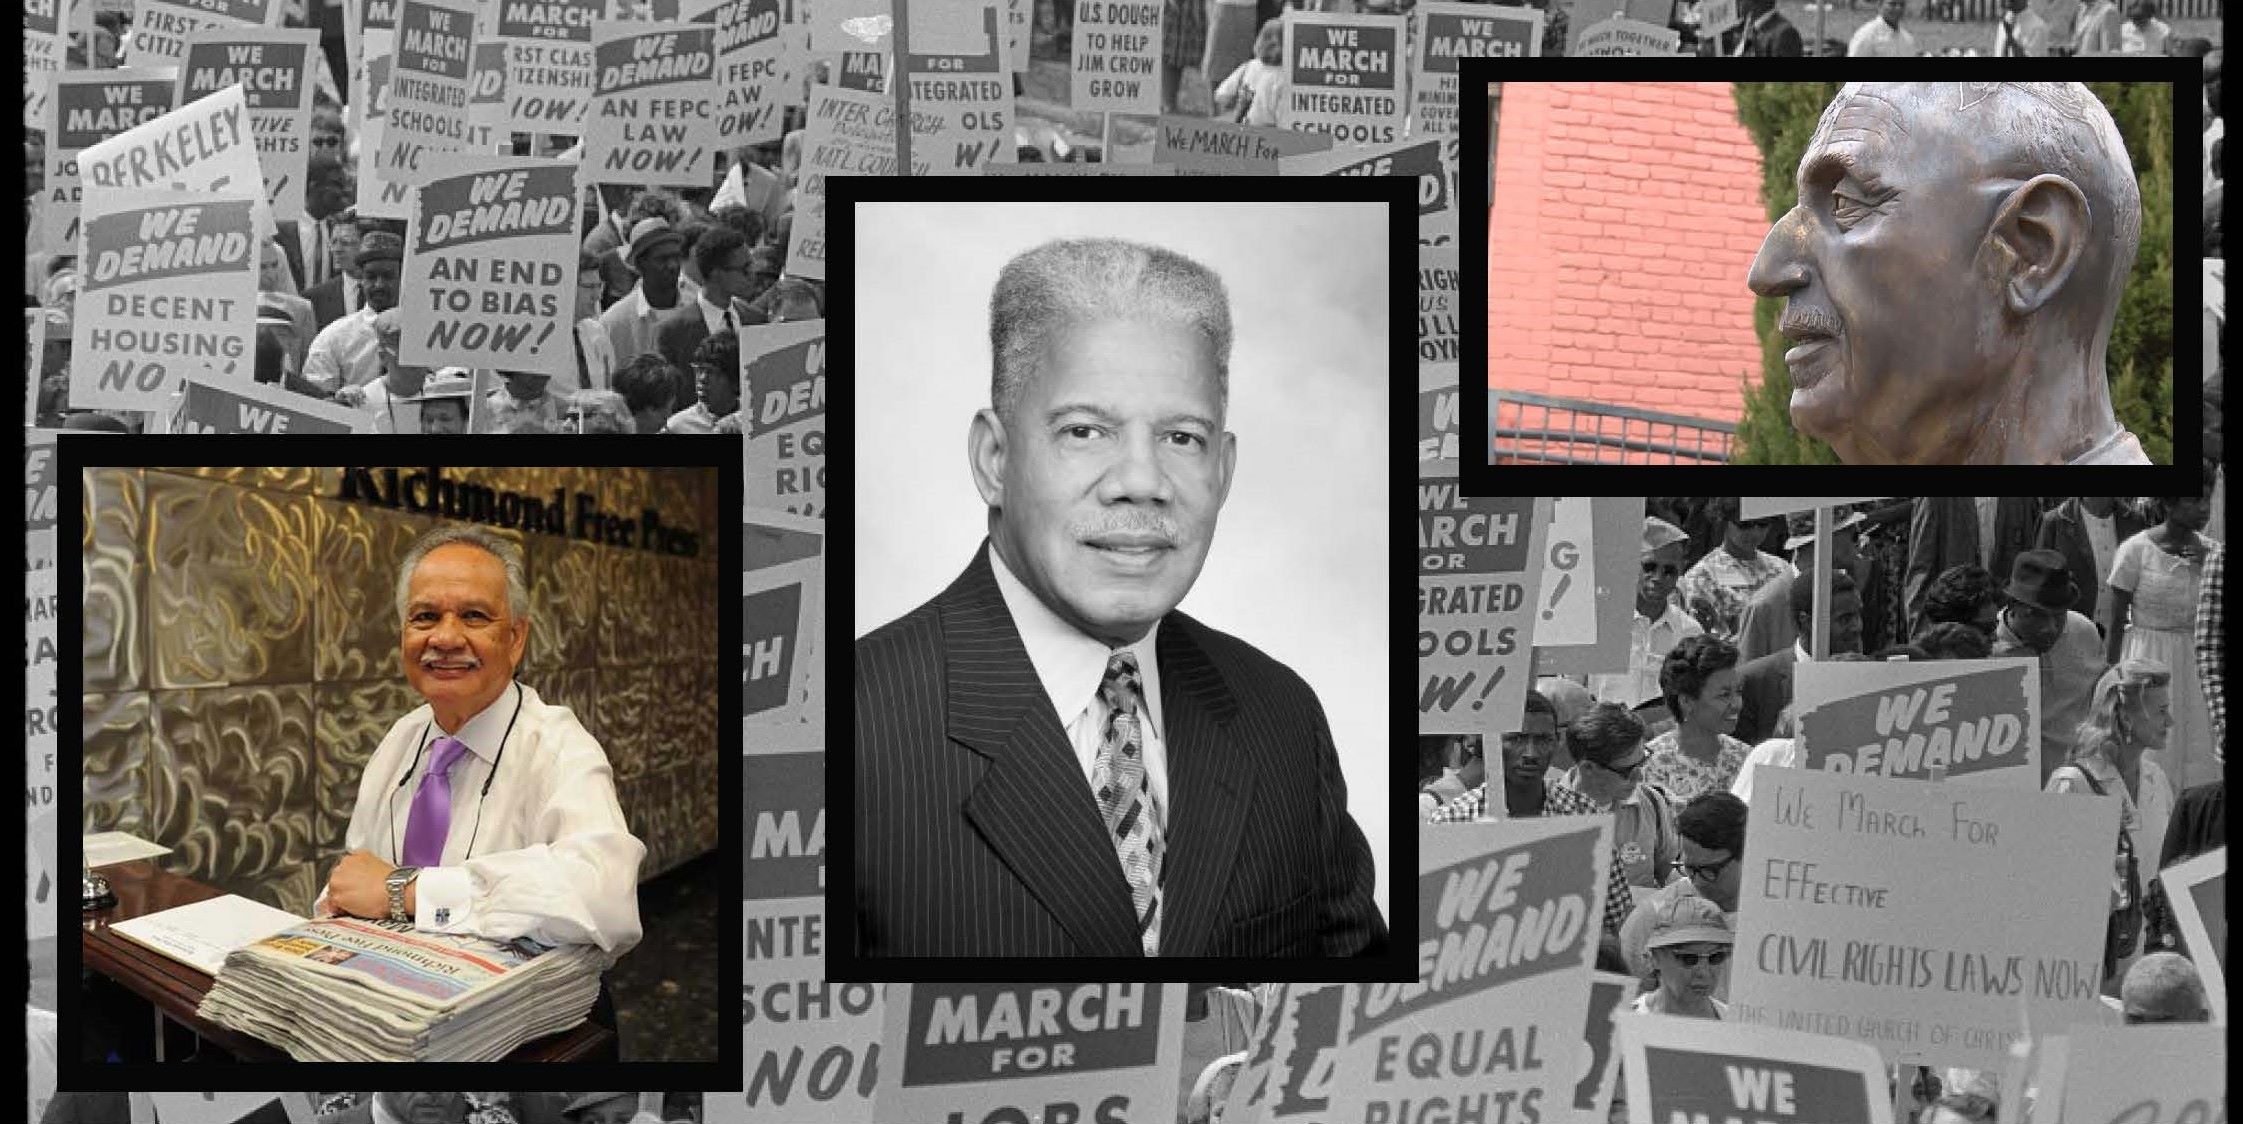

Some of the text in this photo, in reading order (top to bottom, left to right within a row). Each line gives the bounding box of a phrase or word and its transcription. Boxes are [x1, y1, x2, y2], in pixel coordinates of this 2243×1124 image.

[143, 10, 199, 34] FIRST
[429, 9, 451, 31] WE
[505, 3, 598, 27] MARCH
[1108, 3, 1160, 27] DOUGH
[1462, 19, 1494, 36] WE
[532, 25, 569, 38] FOR
[1087, 33, 1149, 52] TO HELP
[1326, 28, 1358, 47] WE
[227, 46, 264, 64] WE
[405, 27, 468, 63] MARCH
[633, 34, 679, 60] WE
[1430, 36, 1522, 58] MARCH
[422, 56, 448, 74] FOR
[601, 52, 711, 91] DEMAND
[728, 57, 777, 82] FEPC
[927, 57, 965, 71] FOR
[1077, 55, 1155, 74] JIM CROW
[1299, 47, 1388, 73] MARCH
[191, 67, 295, 91] MARCH
[911, 80, 1003, 101] TEGRATED
[1089, 80, 1141, 98] GROW
[1325, 72, 1361, 86] FOR
[104, 85, 143, 105] WE
[393, 76, 466, 109] INTEGRATED
[1292, 92, 1396, 116] INTEGRATED
[601, 98, 711, 119] AN FEPC
[718, 103, 774, 137] OW!
[391, 107, 463, 139] SCHOOLS
[624, 122, 687, 143] LAW
[604, 147, 703, 173] NOW!
[469, 170, 530, 205] WE
[139, 207, 202, 240] WE
[426, 197, 571, 245] DEMAND
[93, 232, 247, 282] DEMAND
[429, 256, 562, 286] AN END
[107, 293, 235, 322] DECENT
[429, 288, 558, 317] TO BIAS
[90, 328, 244, 358] HOUSING
[426, 320, 556, 354] NOW!
[238, 403, 290, 434] WE
[1875, 682, 1957, 736] WE
[1823, 713, 2022, 776] DEMAND
[1436, 850, 1531, 930] WE
[1764, 857, 1890, 909] EFFECTIVE
[1758, 933, 2099, 1001] CIVIL RIGHTS LAWS NOW
[924, 983, 1146, 1045] MARCH
[991, 1043, 1075, 1073] FOR
[1374, 1025, 1544, 1083] EQUAL
[1724, 1065, 1797, 1115] WE
